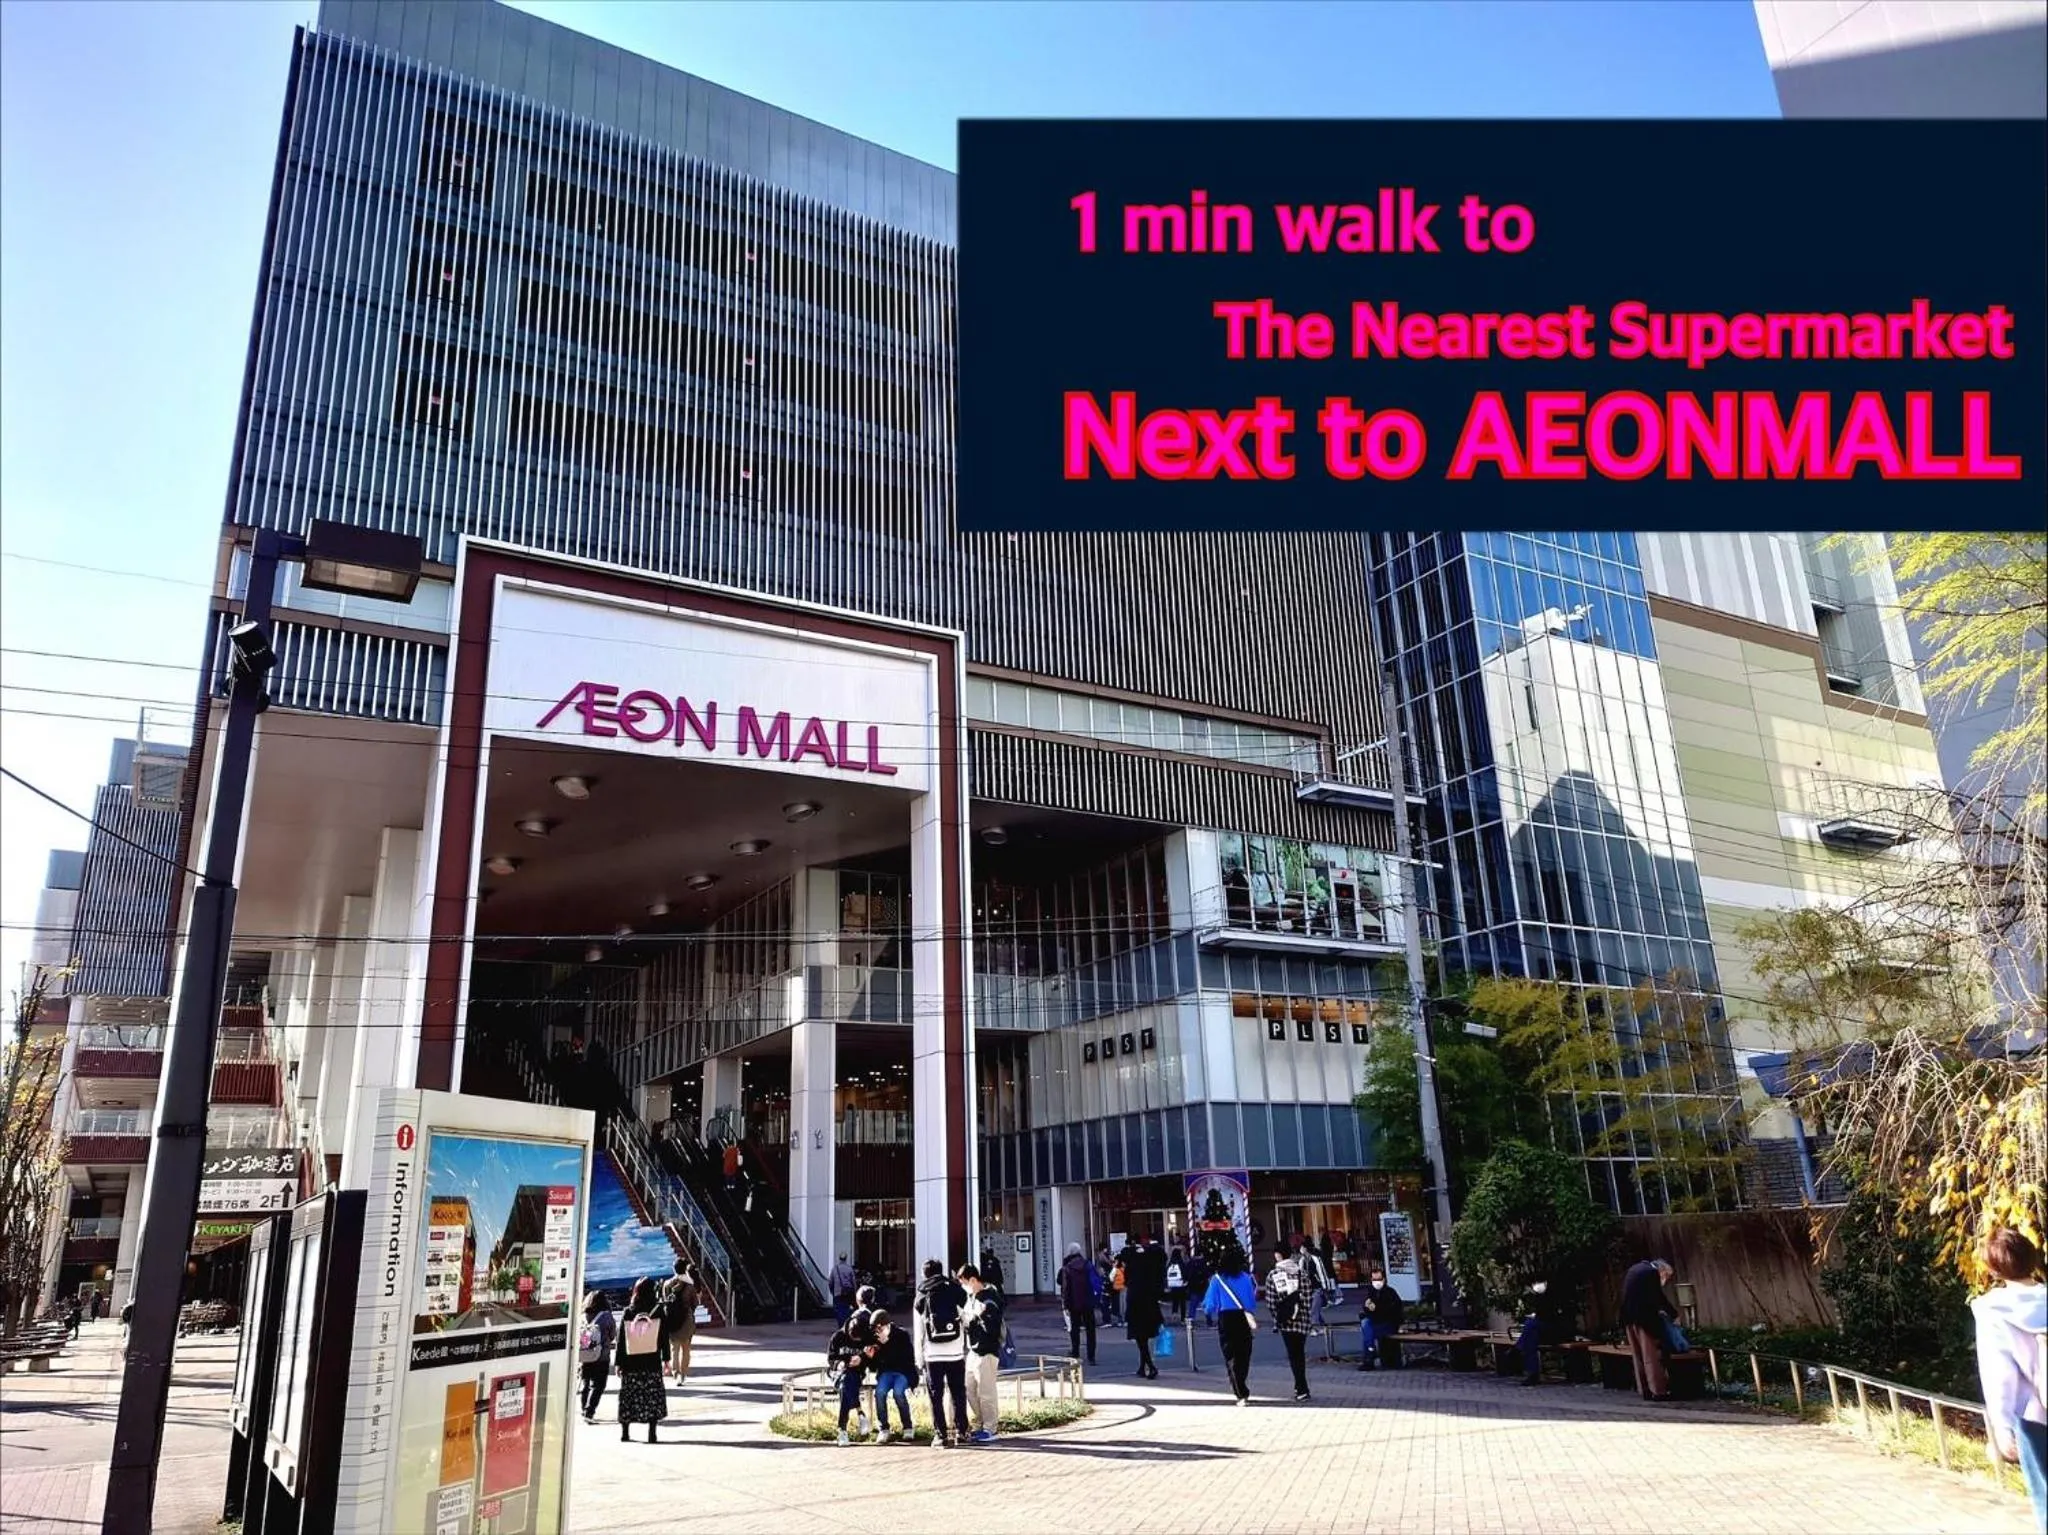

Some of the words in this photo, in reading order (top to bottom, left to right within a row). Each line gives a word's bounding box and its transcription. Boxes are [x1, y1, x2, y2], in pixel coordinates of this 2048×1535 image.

[738, 705, 898, 775] MALL
[1270, 1021, 1367, 1042] PLST
[1085, 1030, 1152, 1062] PLST
[260, 1195, 281, 1208] 2F
[201, 1224, 241, 1236] KEYAKI
[384, 1162, 410, 1297] Information
